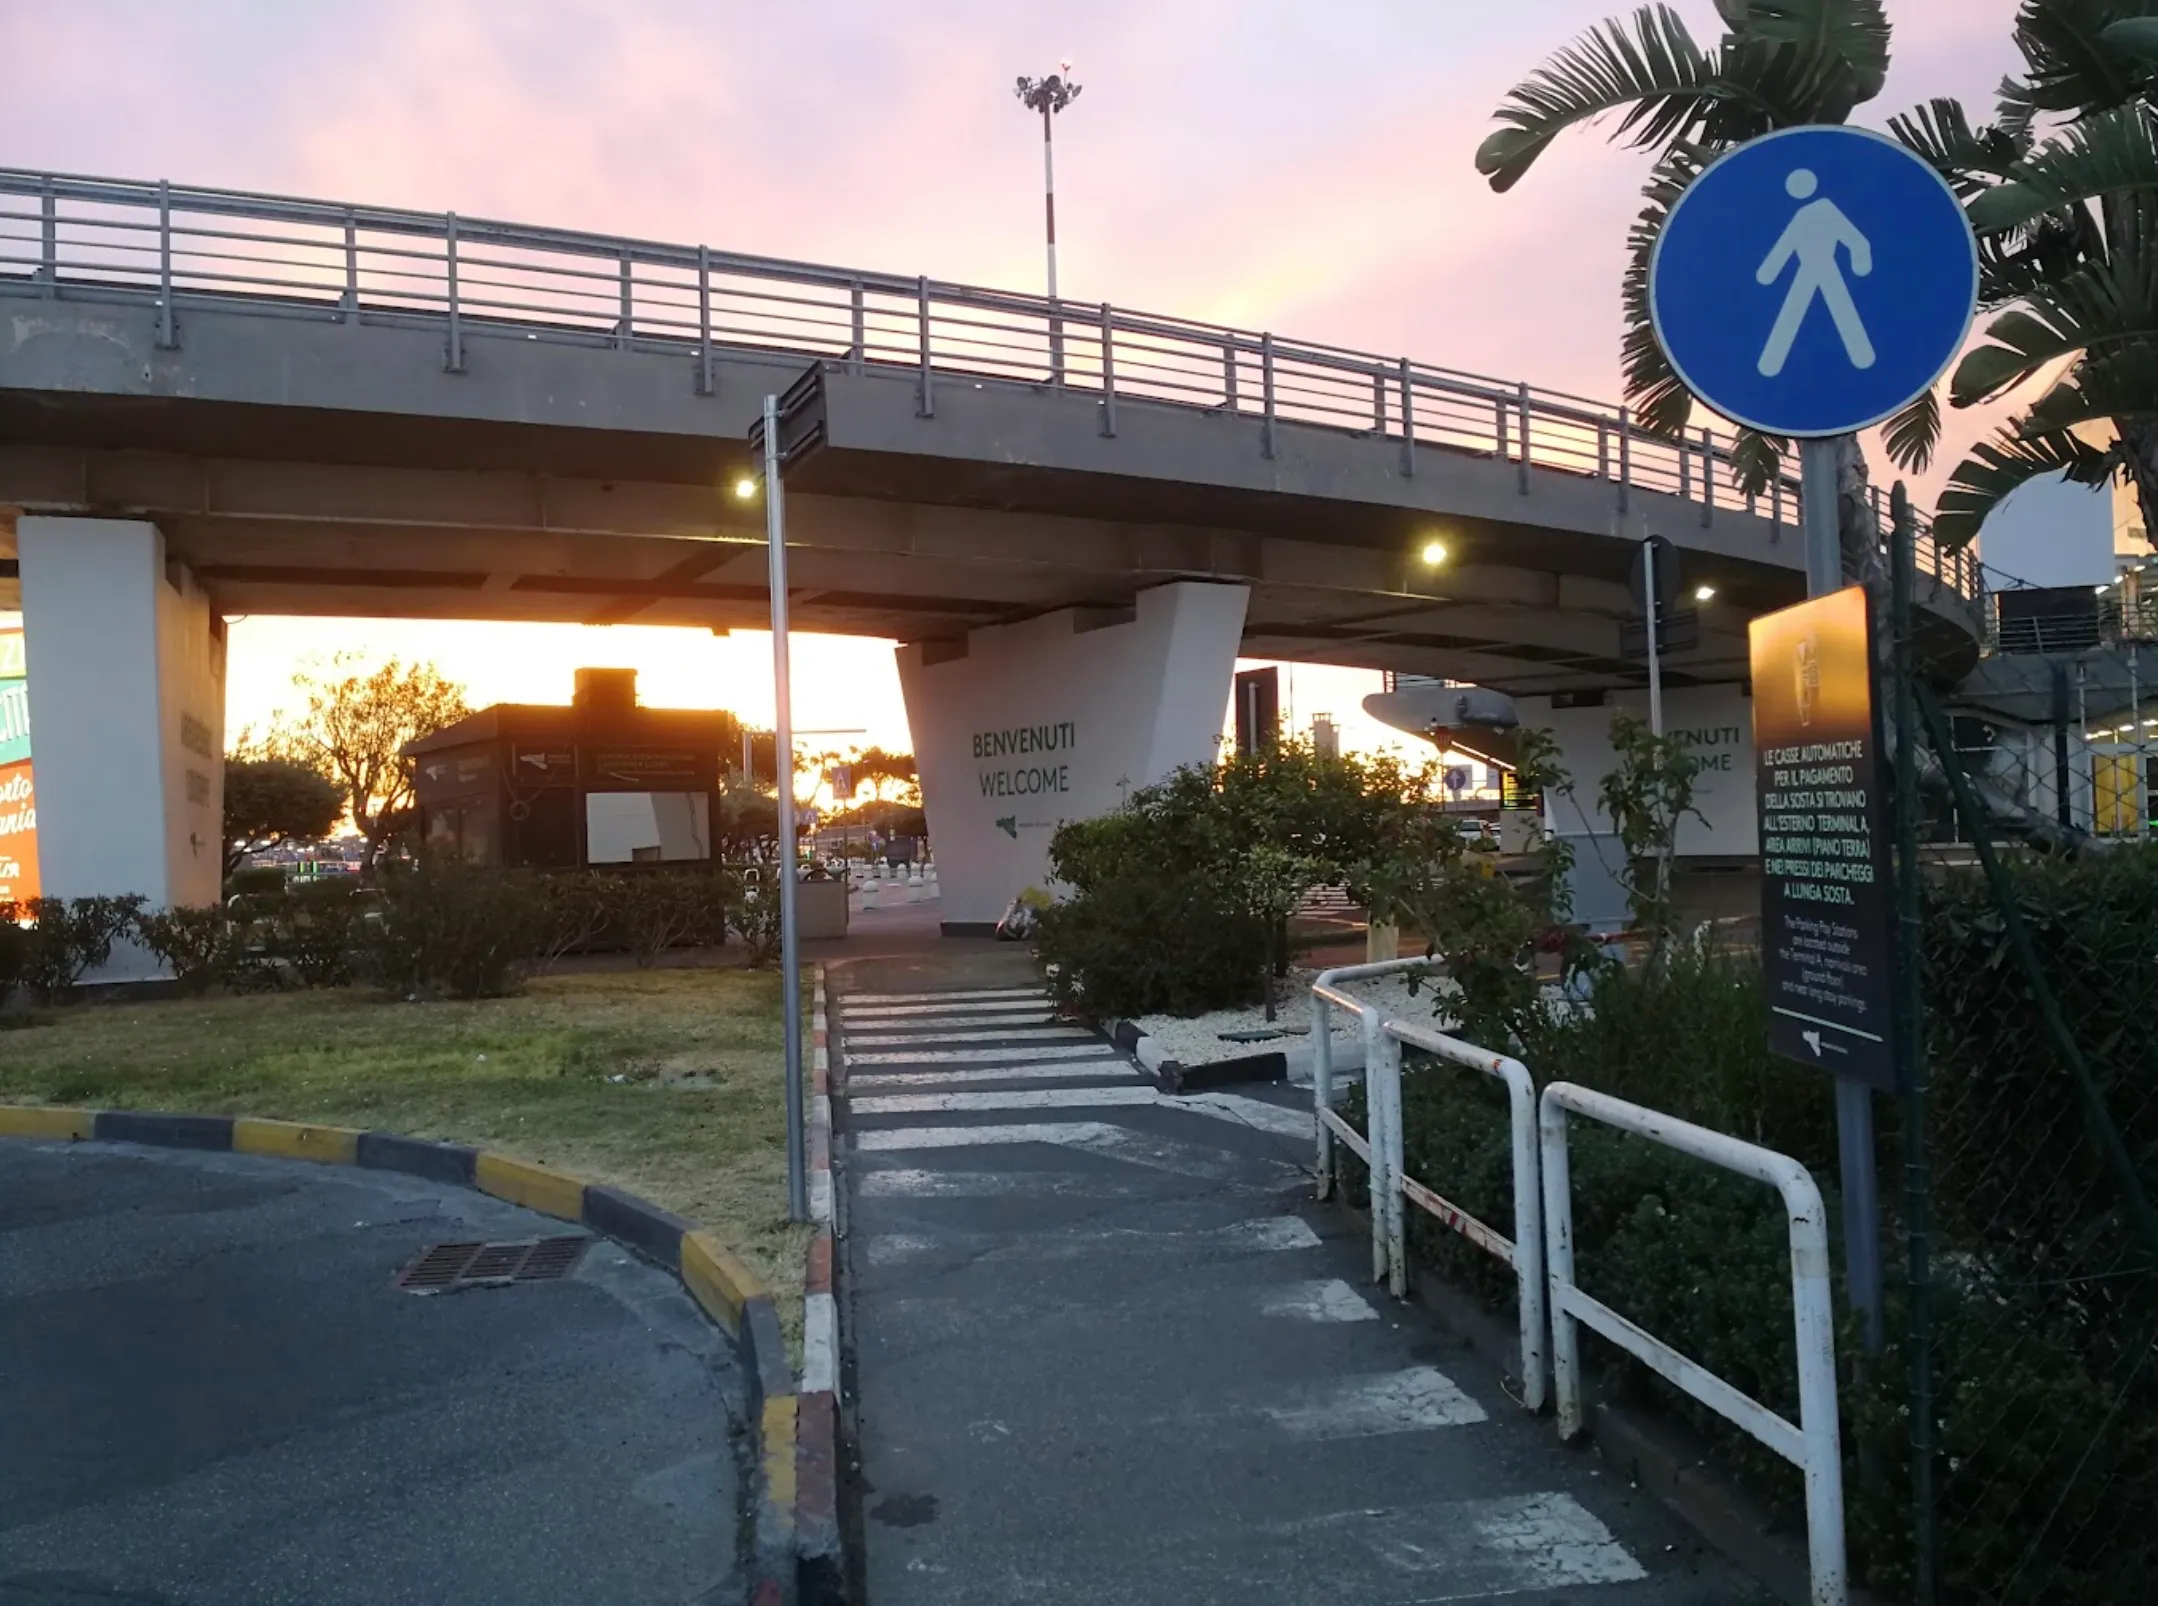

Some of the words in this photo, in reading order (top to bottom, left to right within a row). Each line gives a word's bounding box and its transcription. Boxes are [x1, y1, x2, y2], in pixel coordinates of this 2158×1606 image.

[973, 720, 1075, 758] BENVENUTI
[1764, 749, 1774, 766] LE
[1774, 746, 1800, 766] CASSE
[1801, 740, 1863, 762] AUTOMATICHE
[980, 764, 1070, 797] WELCOME
[1774, 769, 1789, 787] PER
[1790, 769, 1799, 786] IL
[1799, 765, 1854, 786] PAGAMENTO
[1764, 792, 1789, 810] DELLA
[1789, 791, 1816, 809] SOSTA
[1824, 789, 1867, 808] TROVANO
[1817, 814, 1860, 833] TERMINAL
[1765, 837, 1785, 853] AREA
[1786, 837, 1812, 854] ARRIVI
[1812, 836, 1840, 856] (PIANO
[1841, 837, 1871, 859] TERRA)
[1784, 859, 1809, 877] PRESSI
[1811, 860, 1823, 878] DEI
[1824, 860, 1874, 883] PARCHEGGI
[1784, 881, 1791, 898] A
[1791, 882, 1822, 901] LUNGA
